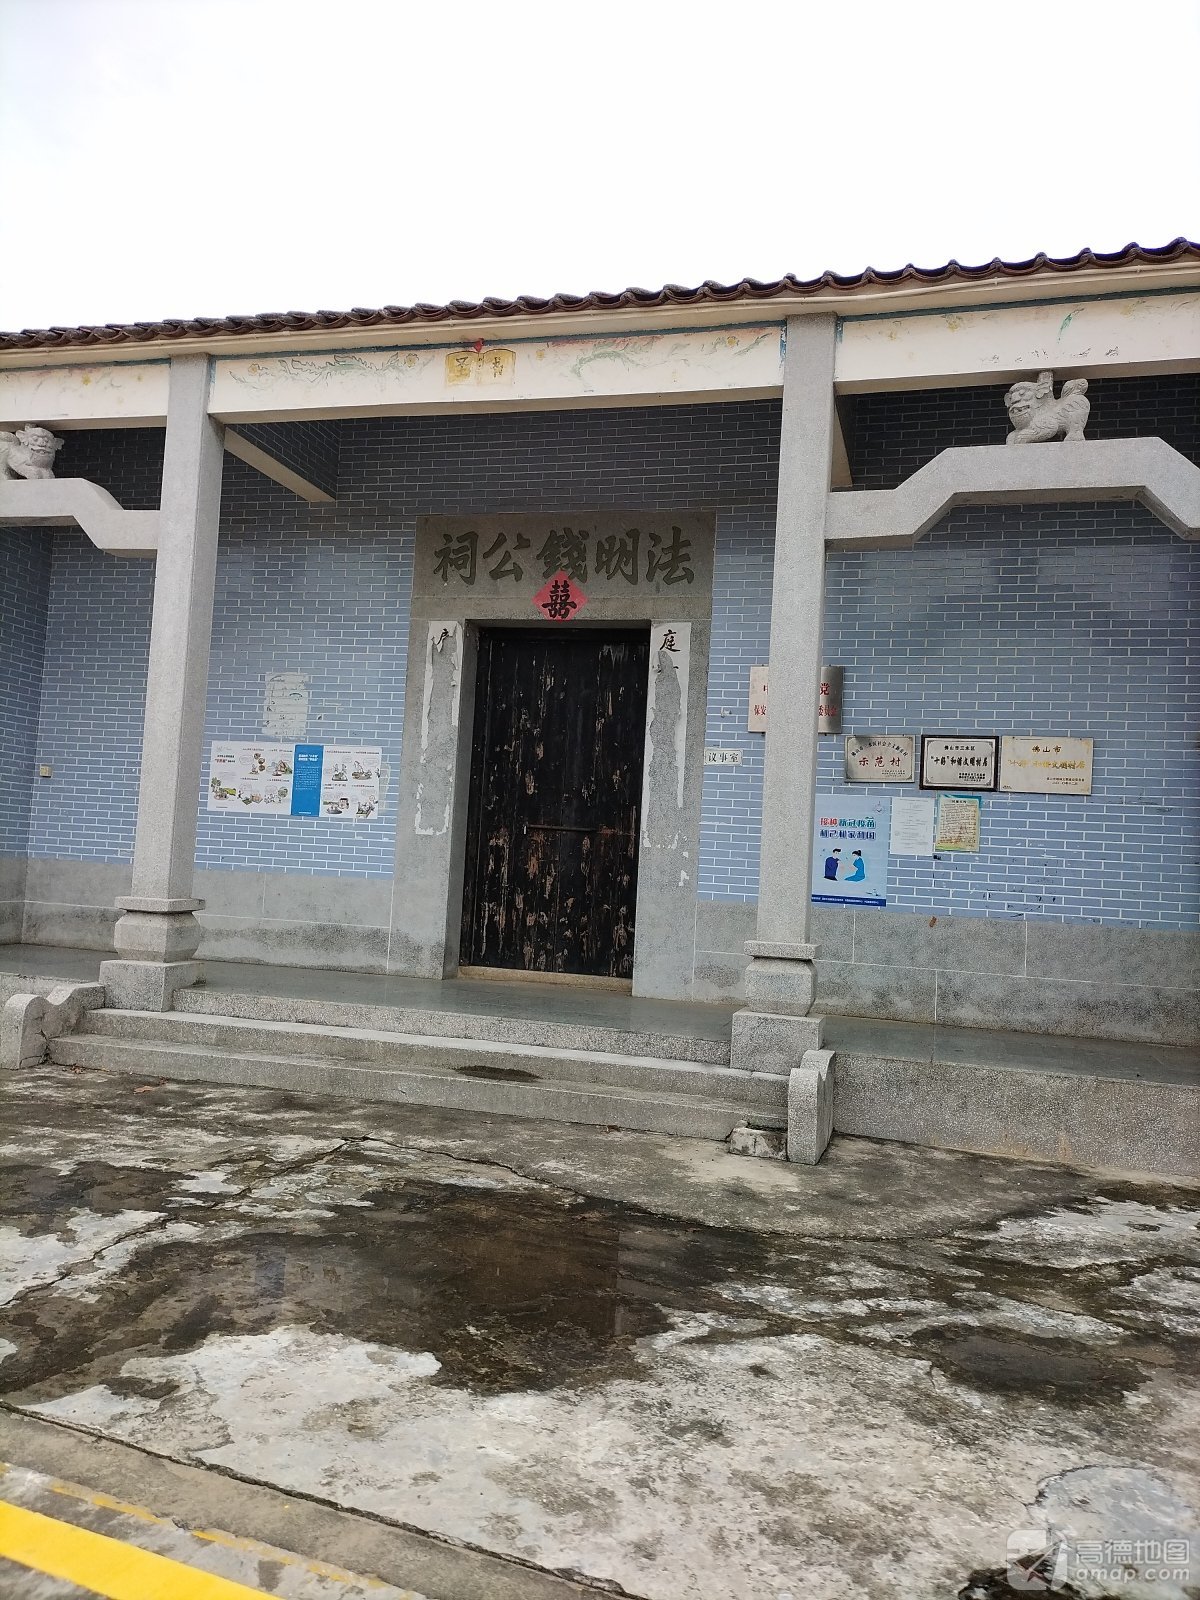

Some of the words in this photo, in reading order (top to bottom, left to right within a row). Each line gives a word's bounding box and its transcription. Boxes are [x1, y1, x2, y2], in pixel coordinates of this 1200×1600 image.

[541, 580, 578, 619] 囍
[659, 629, 681, 652] 庭
[1031, 745, 1062, 755] 佛山市
[708, 752, 739, 763] 议事室
[858, 755, 901, 768] 示范村
